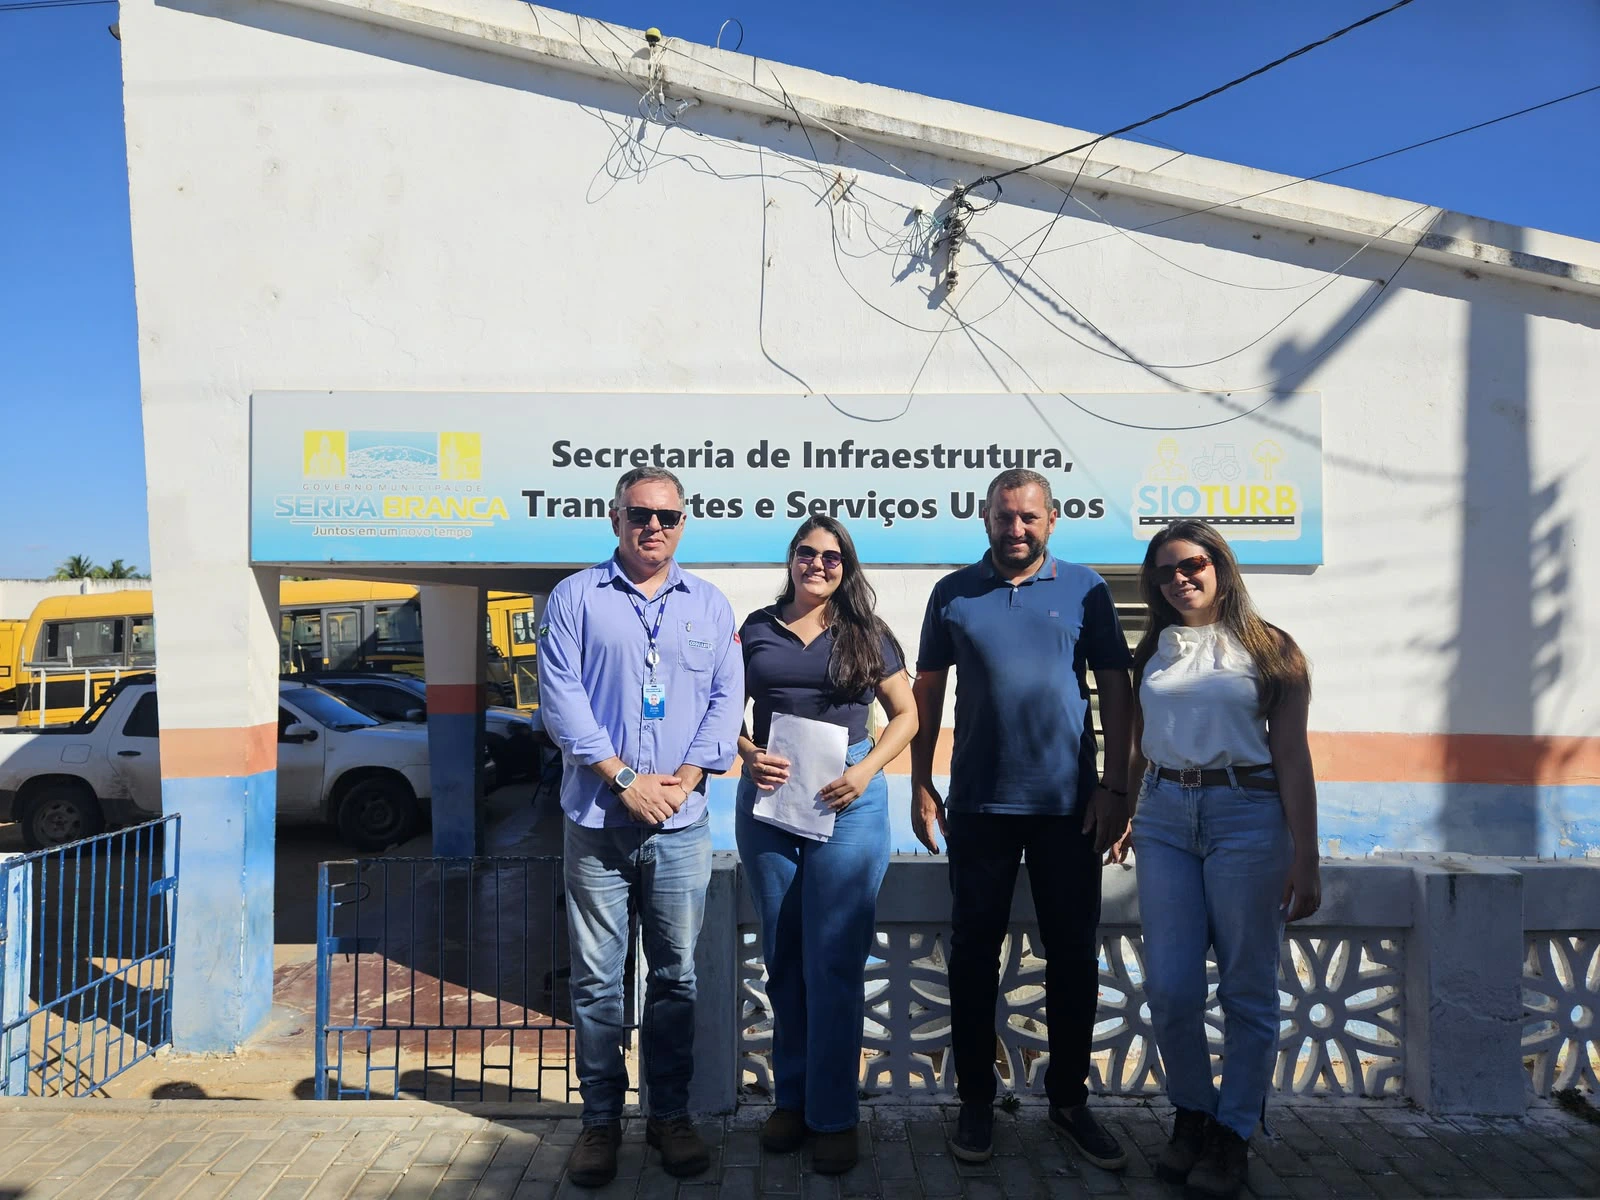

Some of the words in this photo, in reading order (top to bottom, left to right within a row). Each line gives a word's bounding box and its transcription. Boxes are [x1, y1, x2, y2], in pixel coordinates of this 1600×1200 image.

[552, 440, 735, 468] Secretaria
[746, 440, 791, 468] de
[803, 440, 1074, 472] Infraestrutura,
[302, 483, 373, 492] GOVERNO
[378, 483, 459, 492] MUNICIPAL
[466, 484, 482, 493] DE
[1137, 485, 1297, 515] SIOTURB
[275, 496, 377, 517] SERRA
[383, 496, 509, 519] BRANCA
[521, 490, 744, 518] Trantes
[754, 497, 775, 518] e
[786, 490, 938, 527] Serviços
[313, 526, 355, 536] Juntos
[358, 528, 376, 536] em
[380, 528, 398, 536] um
[400, 528, 431, 537] novo
[434, 528, 472, 538] tempo
